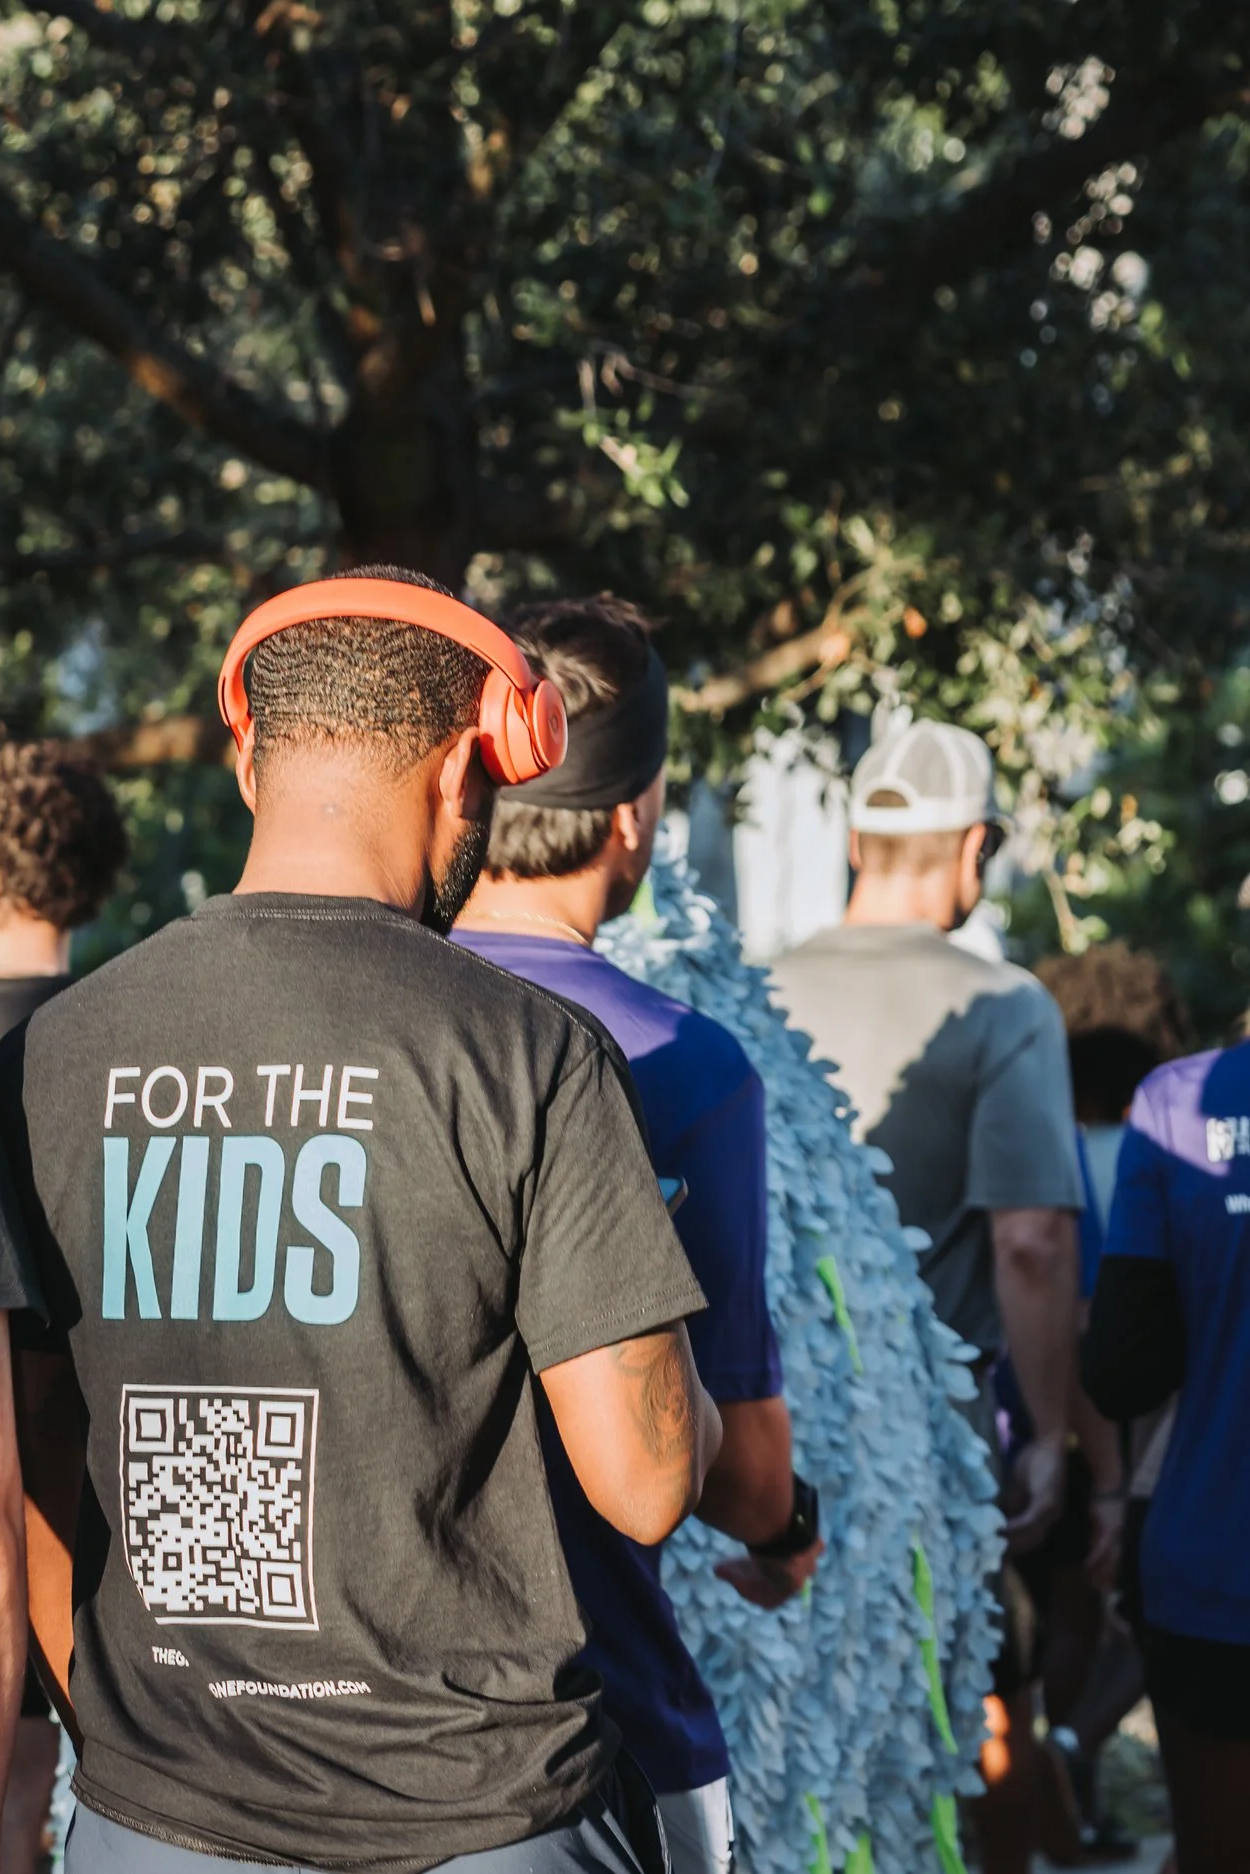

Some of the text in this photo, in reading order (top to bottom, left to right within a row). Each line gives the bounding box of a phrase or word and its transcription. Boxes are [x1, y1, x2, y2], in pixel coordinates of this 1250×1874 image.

[104, 1064, 379, 1130] FOR THE
[102, 1134, 367, 1325] KIDS
[152, 1646, 190, 1667] THEG
